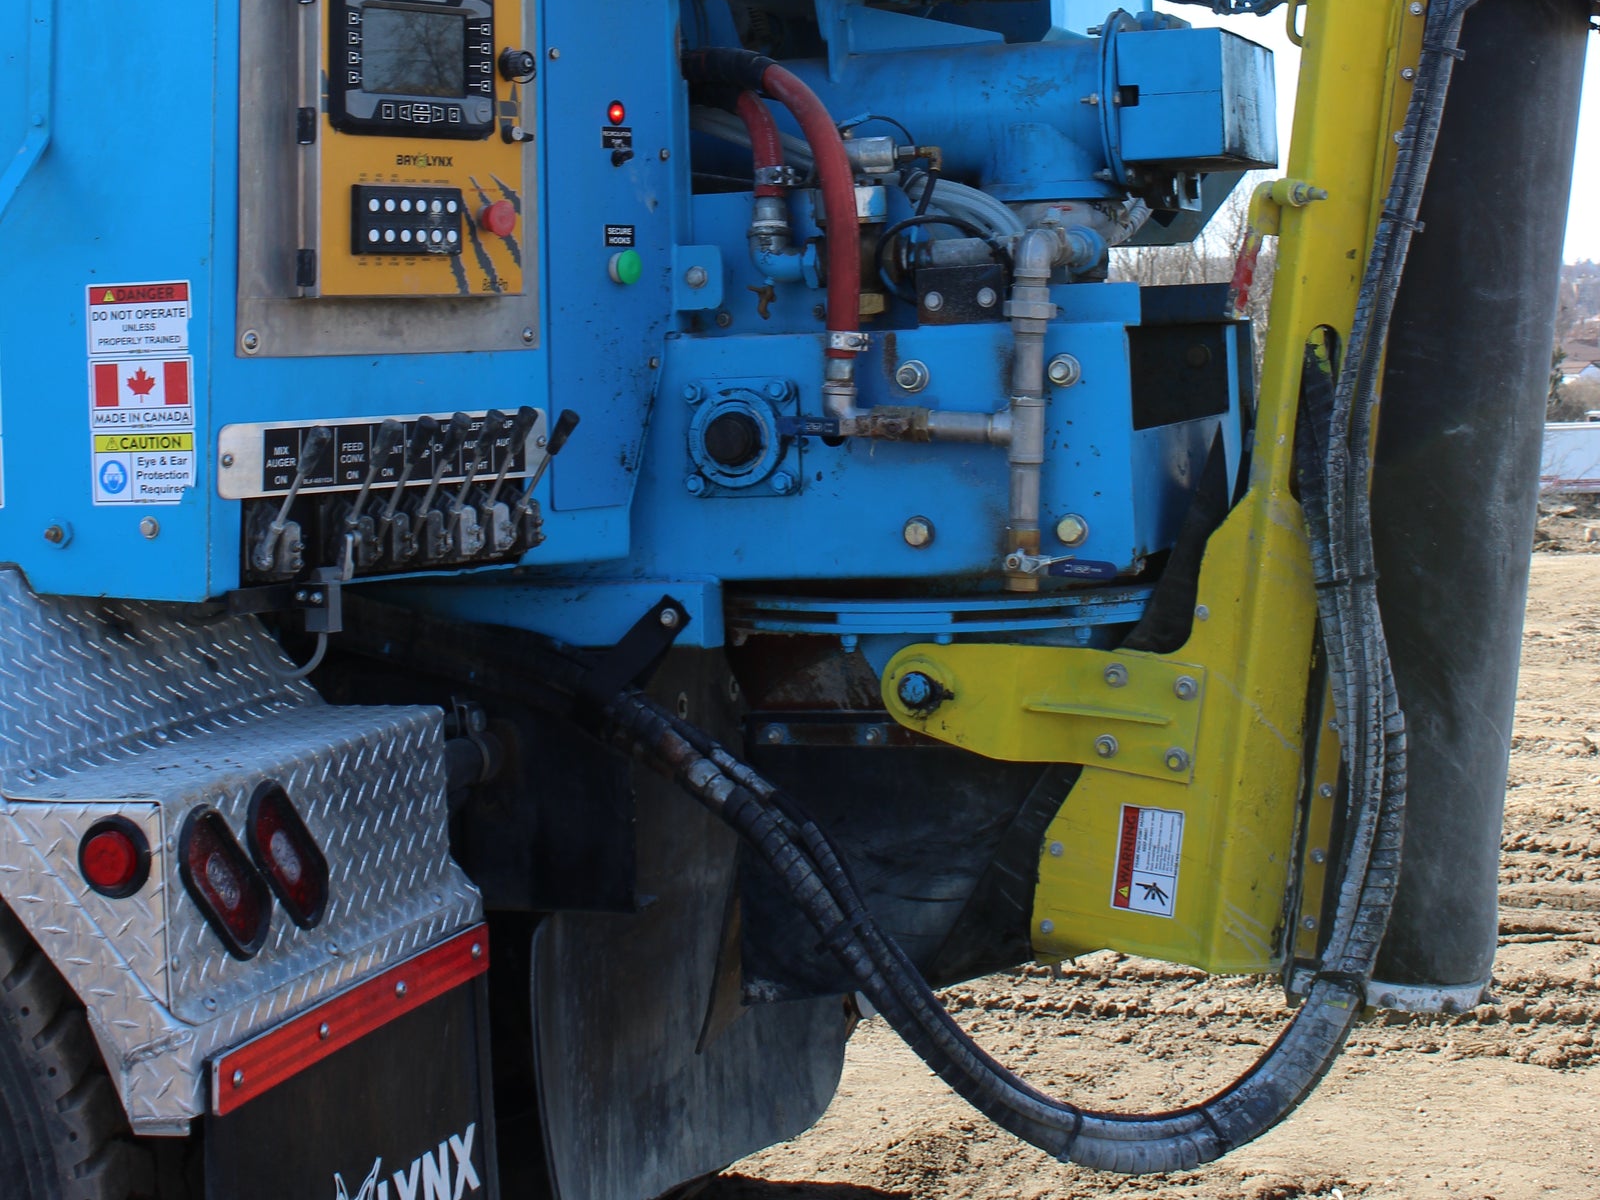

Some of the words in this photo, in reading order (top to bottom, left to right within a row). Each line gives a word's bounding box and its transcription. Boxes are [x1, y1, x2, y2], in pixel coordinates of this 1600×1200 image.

[426, 154, 453, 167] LYNX
[607, 227, 633, 235] SECURE
[609, 236, 631, 244] HOOKS
[116, 287, 174, 301] DANGER
[92, 311, 108, 321] DO
[110, 310, 132, 320] NOT
[135, 307, 186, 319] OPERATE
[122, 323, 156, 332] UNLESS
[98, 337, 143, 346] PROPERLY
[144, 335, 181, 344] TRAINED
[95, 413, 126, 424] MADE
[129, 413, 140, 423] IN
[143, 411, 190, 422] CANADA
[120, 436, 182, 449] CAUTION
[342, 442, 364, 452] FEED
[273, 446, 290, 456] MIX
[137, 456, 156, 468] Eye
[160, 456, 167, 466] &
[170, 455, 188, 466] Ear
[265, 457, 297, 469] AUGER
[136, 470, 189, 480] Protection
[345, 470, 360, 480] ON
[381, 467, 395, 477] ON
[274, 475, 288, 485] ON
[1120, 815, 1137, 882] WARNING
